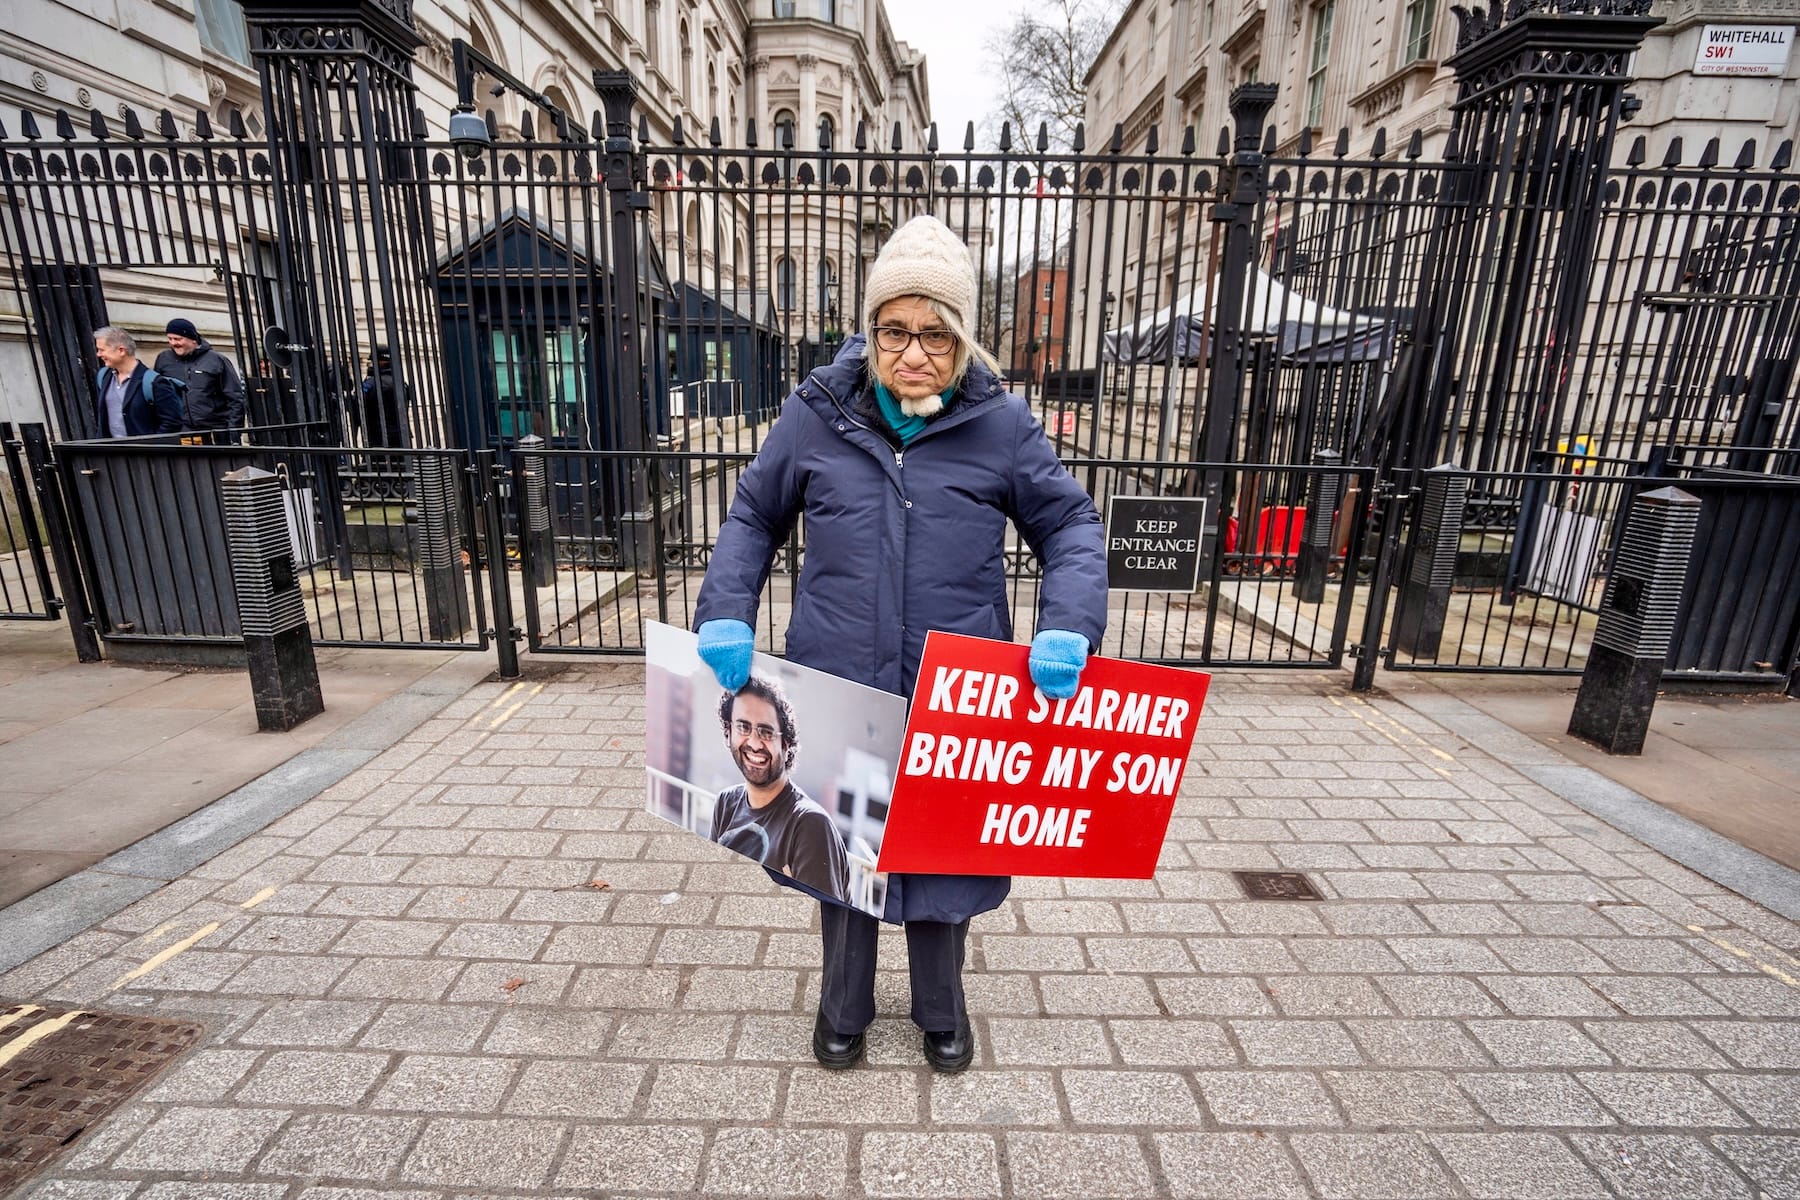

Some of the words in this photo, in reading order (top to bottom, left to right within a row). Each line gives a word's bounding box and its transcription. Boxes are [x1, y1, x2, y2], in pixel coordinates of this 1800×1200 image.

[1709, 30, 1785, 43] WHITEHALL
[1705, 45, 1734, 58] SW1
[1135, 520, 1178, 534] KEEP
[1110, 537, 1196, 553] ENTRANCE
[1124, 556, 1178, 570] CLEAR
[928, 666, 1020, 720] KEIR
[905, 731, 1033, 785] BRING
[1041, 746, 1104, 789] MY
[1106, 752, 1182, 796] SON
[979, 803, 1092, 848] HOME
